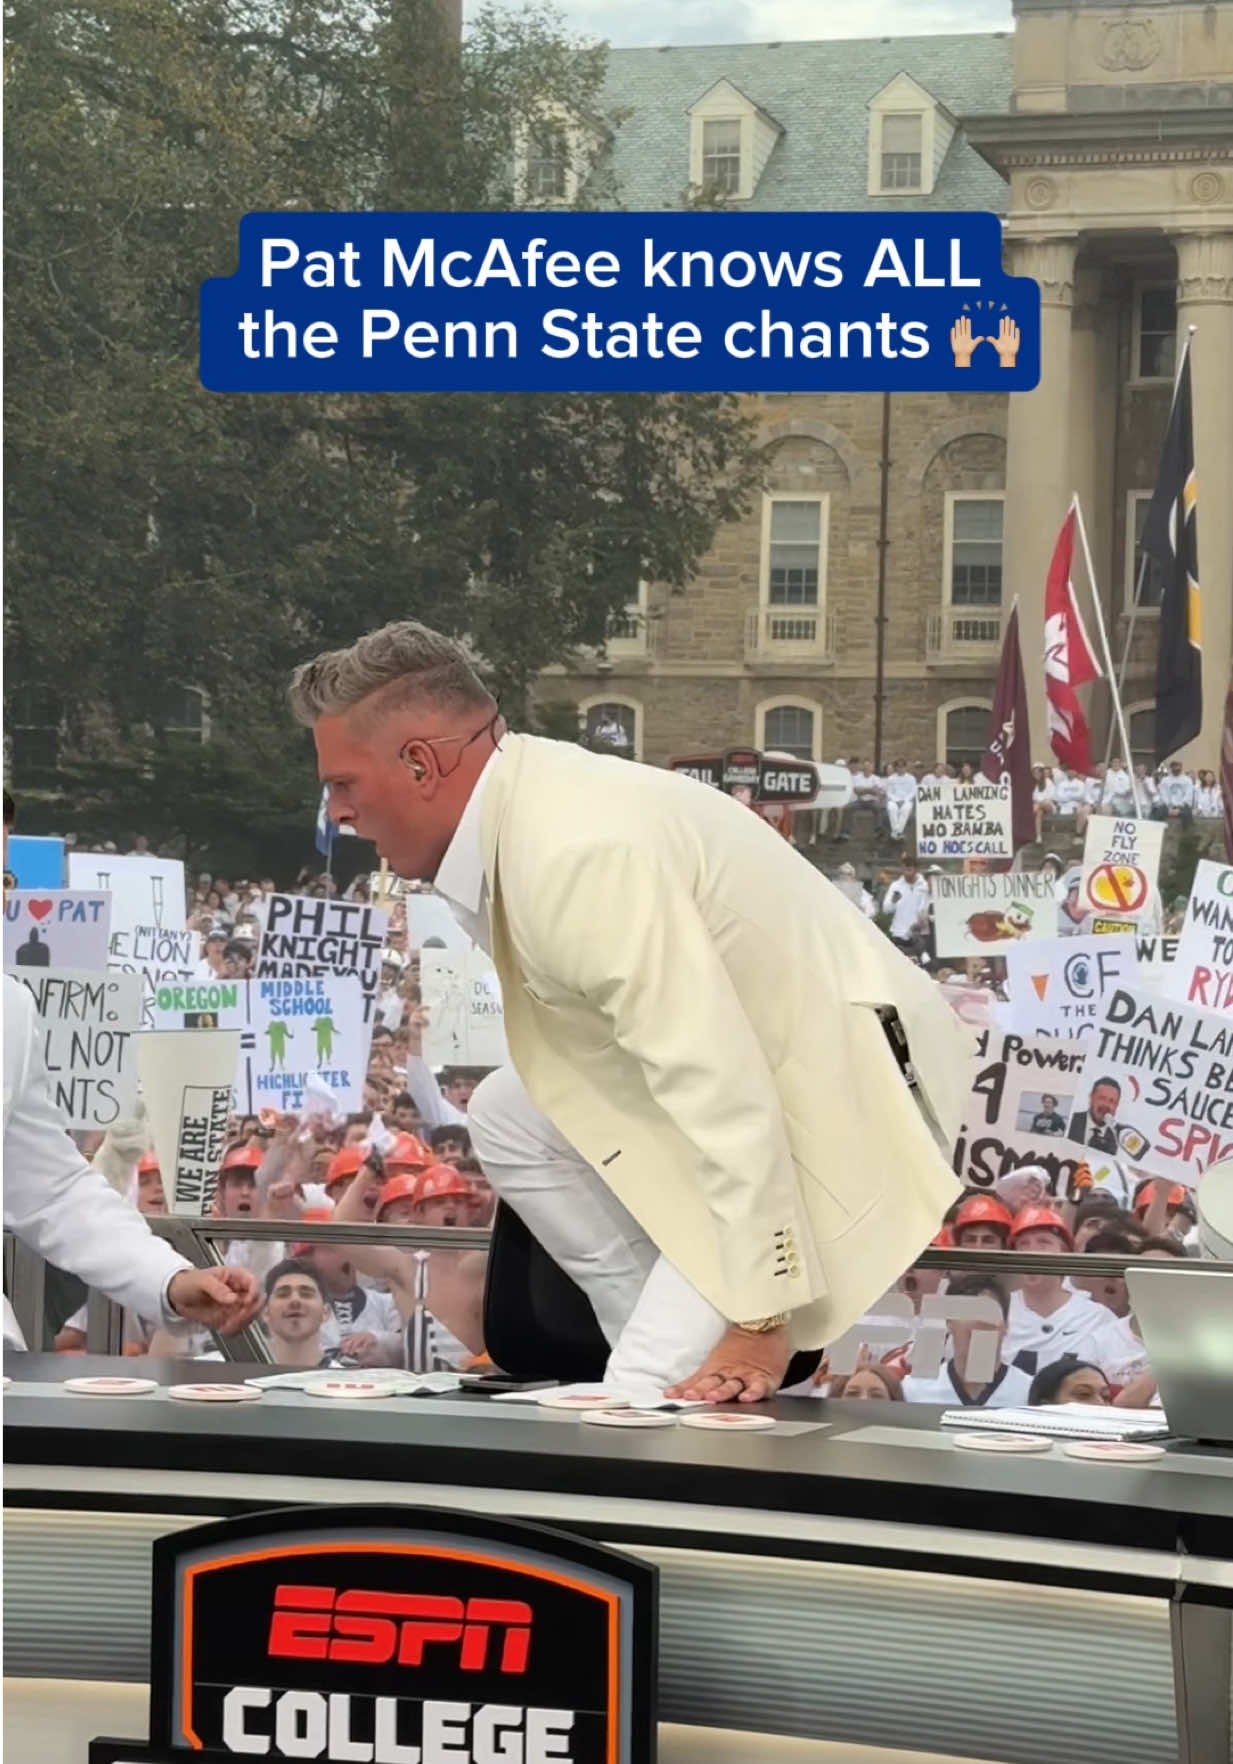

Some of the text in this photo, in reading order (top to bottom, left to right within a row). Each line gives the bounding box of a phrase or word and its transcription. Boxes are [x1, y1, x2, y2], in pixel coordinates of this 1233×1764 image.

[764, 772, 811, 792] GATE
[917, 786, 1009, 802] DAN LANNING
[932, 804, 986, 821] HATES
[922, 822, 1004, 838] MO BAMBA
[1113, 821, 1137, 835] NO
[919, 842, 937, 854] NO
[1111, 835, 1138, 850] FLY
[1103, 850, 1141, 865] ZONE
[936, 874, 1056, 899] TONIGHTS DINNER
[59, 900, 105, 922] PAT
[266, 896, 383, 942] PHIL
[134, 937, 190, 964] LION
[261, 933, 381, 969] KNIGHT
[1136, 938, 1179, 963] WE
[157, 984, 238, 1010] OREGON
[260, 980, 325, 998] MIDDLE
[269, 997, 333, 1016] SCHOOL
[1060, 1004, 1097, 1017] THE
[1105, 989, 1183, 1041] DAN
[70, 1026, 131, 1073] NOT
[1097, 1027, 1199, 1080] THINKS
[1145, 1077, 1233, 1130] SAUCE
[176, 1115, 208, 1203] WE ARE
[201, 1088, 231, 1217] ENN STATE
[268, 1584, 532, 1673] ESPN
[223, 1686, 575, 1764] COLLEGE
